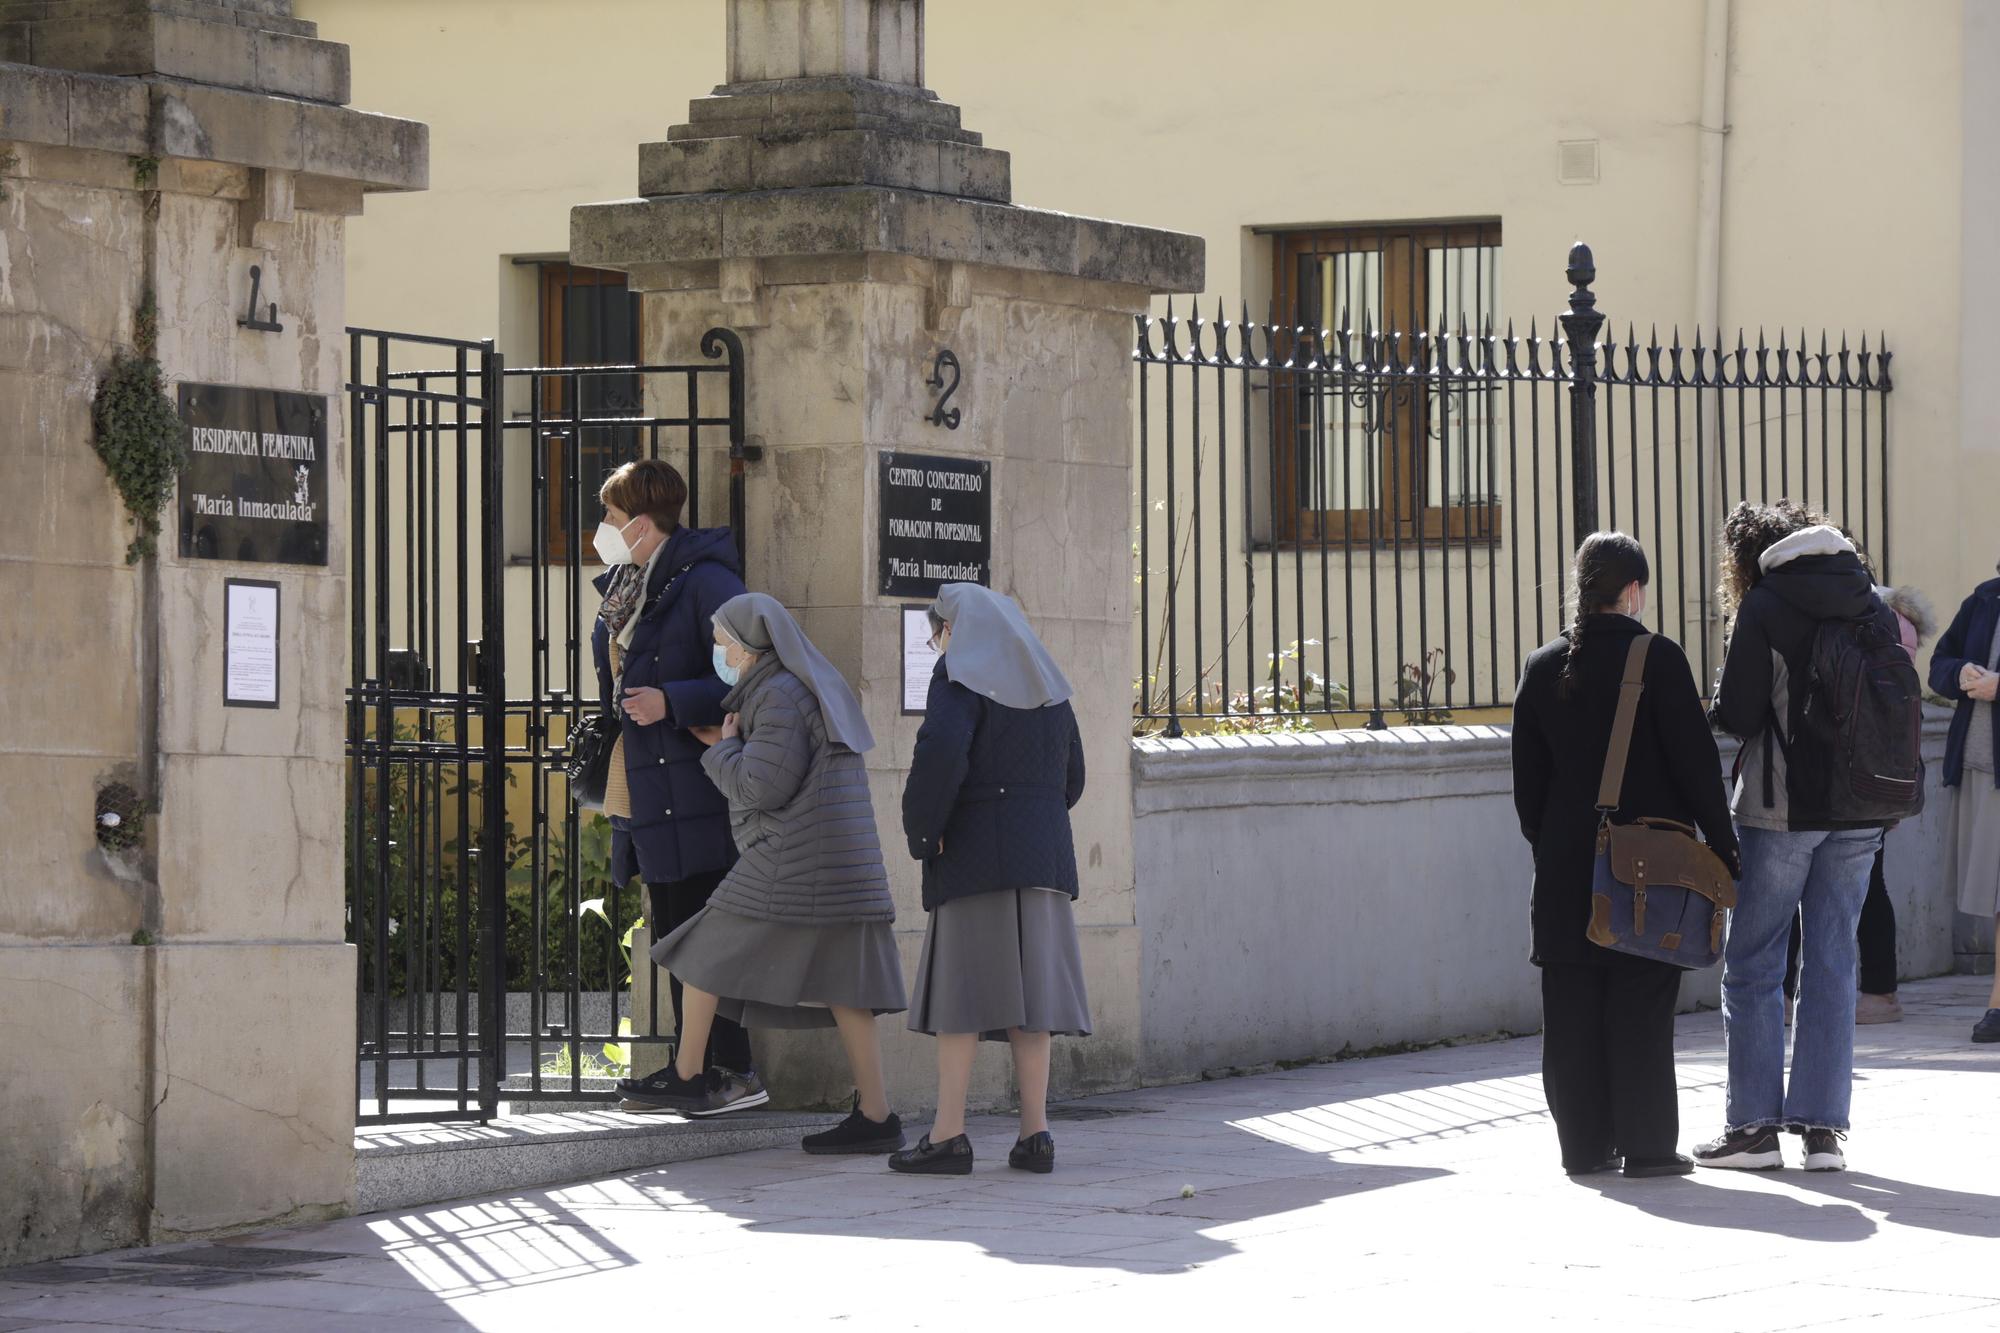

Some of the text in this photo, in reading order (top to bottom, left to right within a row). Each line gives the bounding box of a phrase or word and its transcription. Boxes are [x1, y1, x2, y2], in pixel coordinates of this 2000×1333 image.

[934, 350, 961, 430] 2
[192, 427, 315, 461] RESIDENCIA FEMENINA
[889, 467, 982, 492] CENTRO CONCERTADO
[192, 493, 317, 522] "María Inmaculada"
[931, 498, 942, 511] DE
[889, 518, 982, 542] FORMACION PROFESIONAL
[888, 557, 982, 581] "María Inmaculada"
